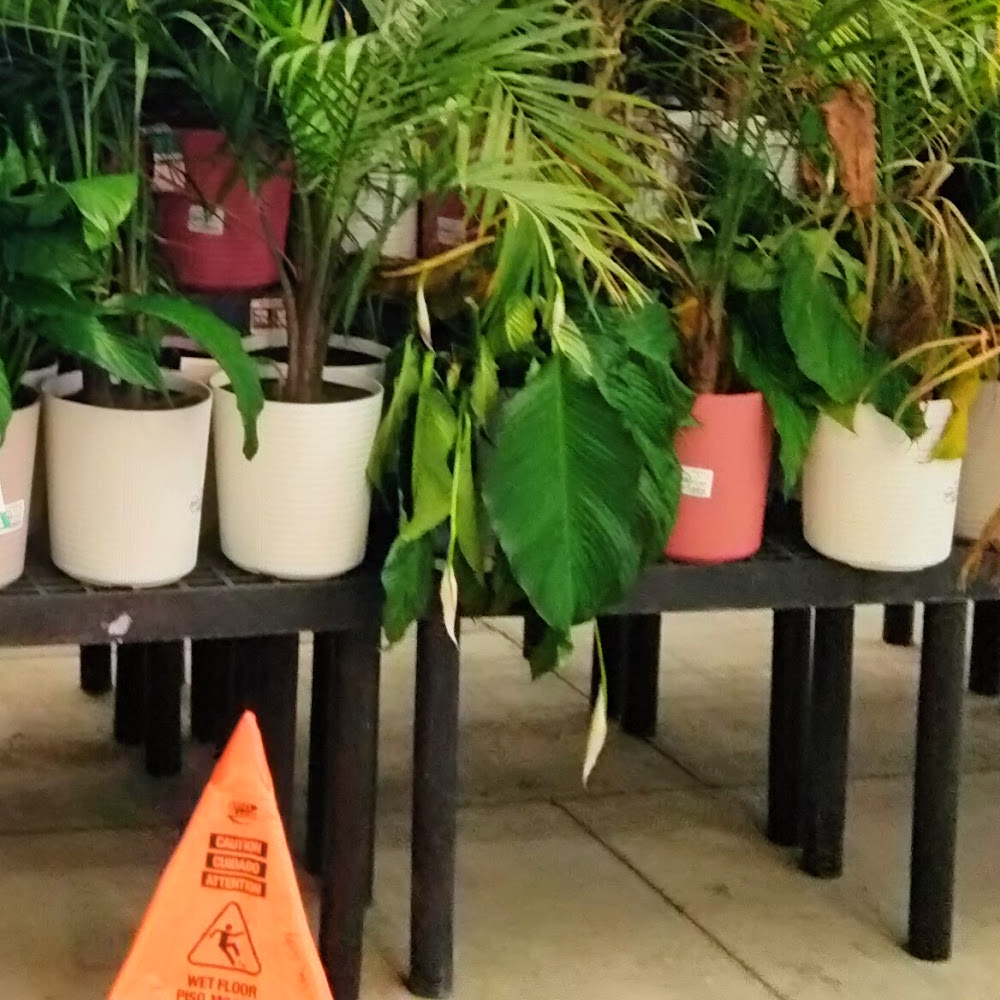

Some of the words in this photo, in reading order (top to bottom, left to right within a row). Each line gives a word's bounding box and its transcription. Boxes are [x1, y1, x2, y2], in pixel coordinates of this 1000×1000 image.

[215, 835, 263, 855] CAUTION
[212, 855, 261, 876] CUIDADO
[205, 873, 262, 895] ATTENTION
[187, 975, 214, 990] WET
[217, 978, 257, 999] FLOOR
